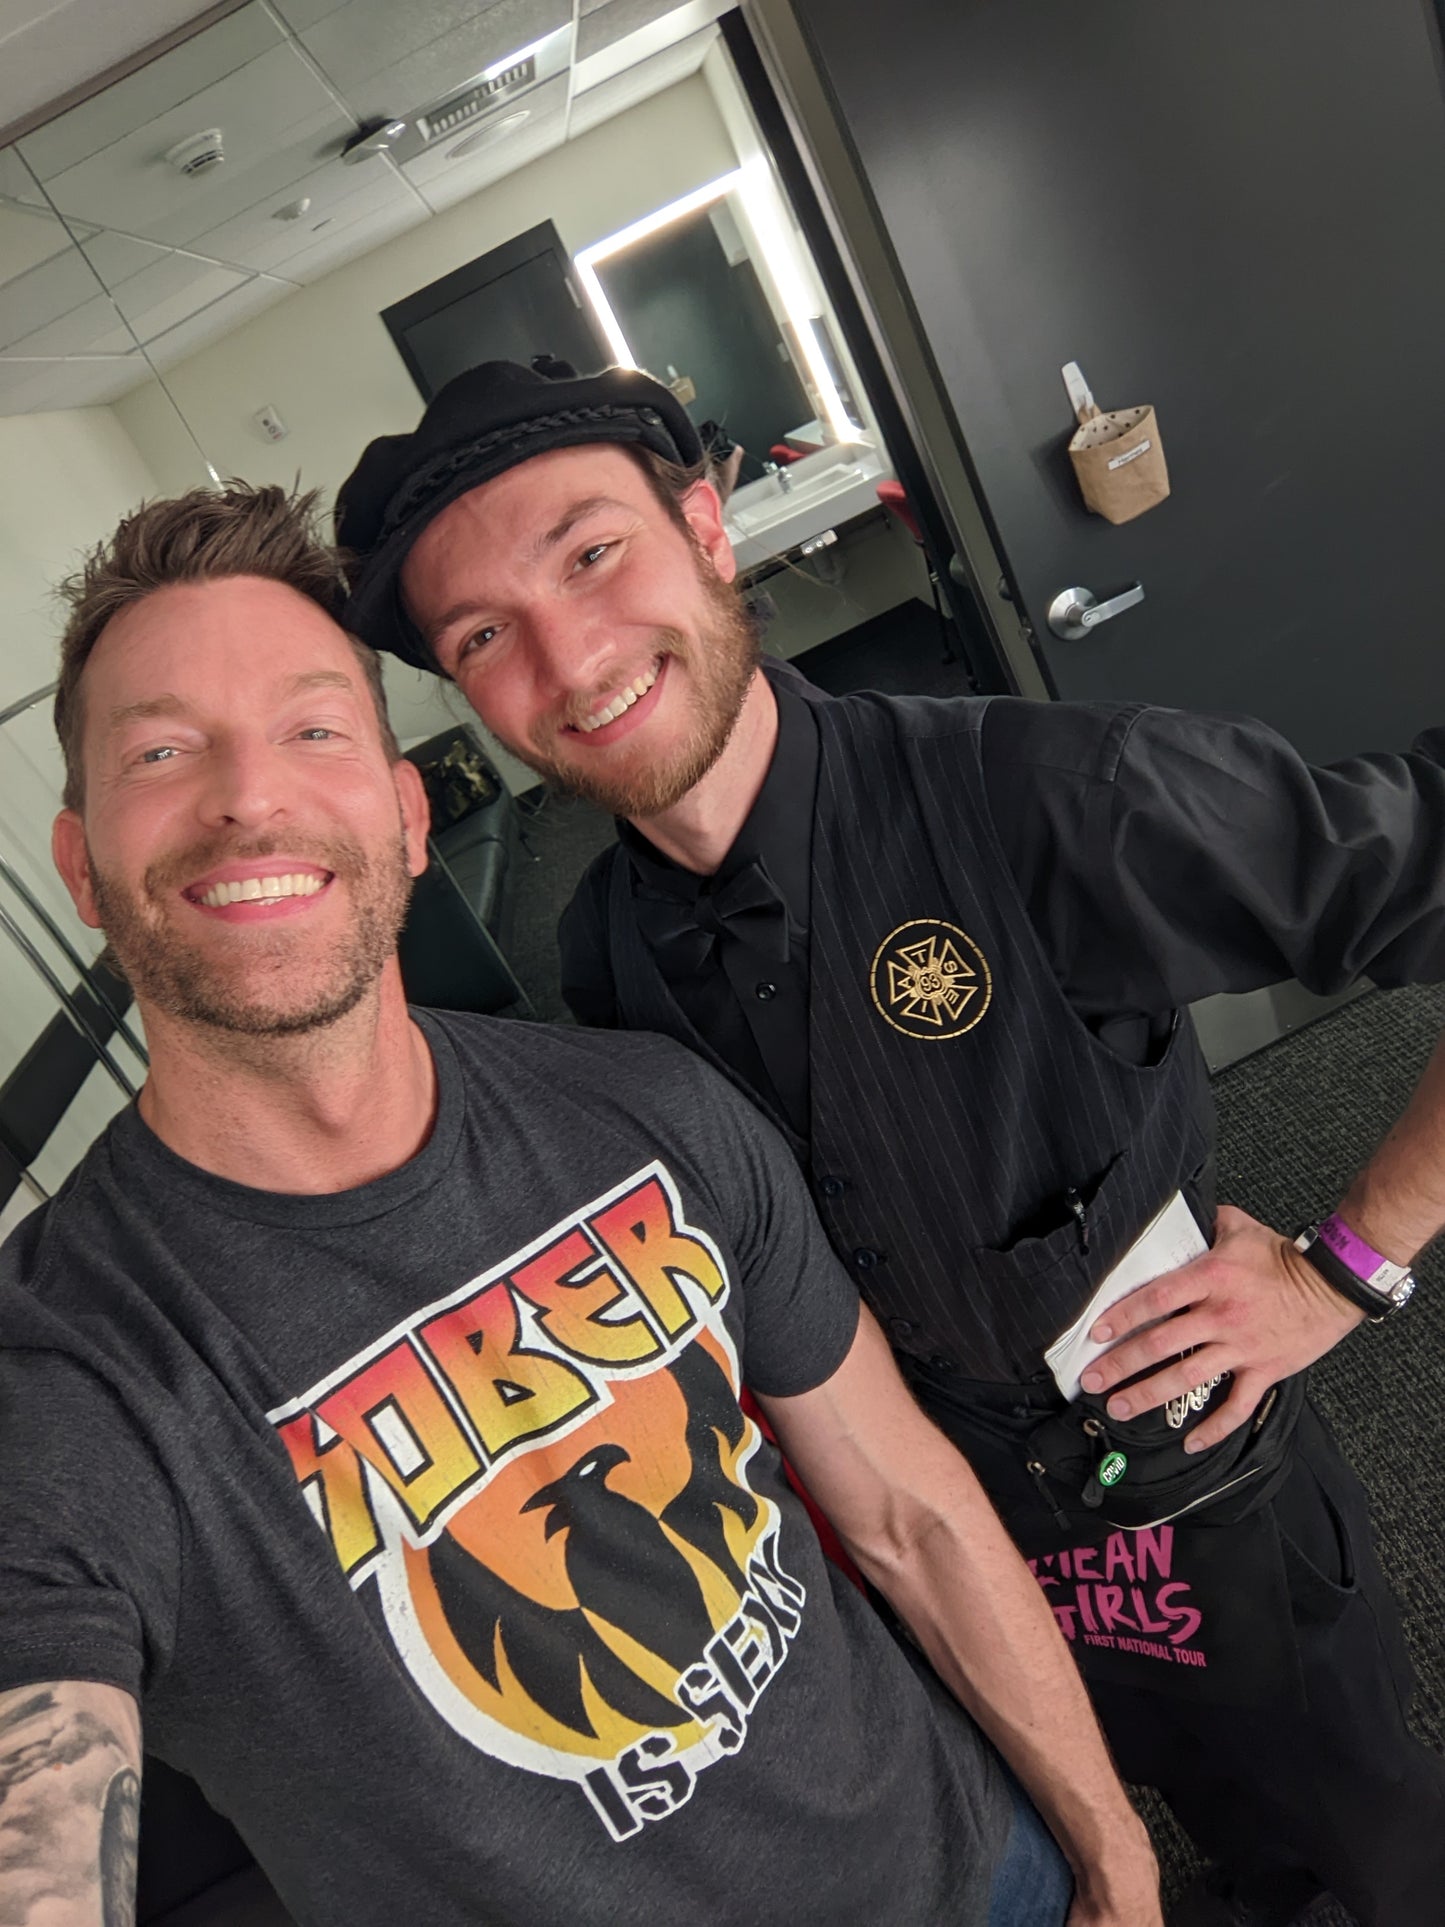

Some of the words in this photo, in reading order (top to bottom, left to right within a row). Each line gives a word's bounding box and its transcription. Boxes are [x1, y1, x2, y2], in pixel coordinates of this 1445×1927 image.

[920, 973, 941, 992] 93
[1083, 1635, 1115, 1648] FIRST
[1116, 1637, 1172, 1661] NATIONAL
[1173, 1647, 1207, 1667] TOUR
[583, 1732, 697, 1842] IS
[673, 1530, 806, 1756] SEXY
